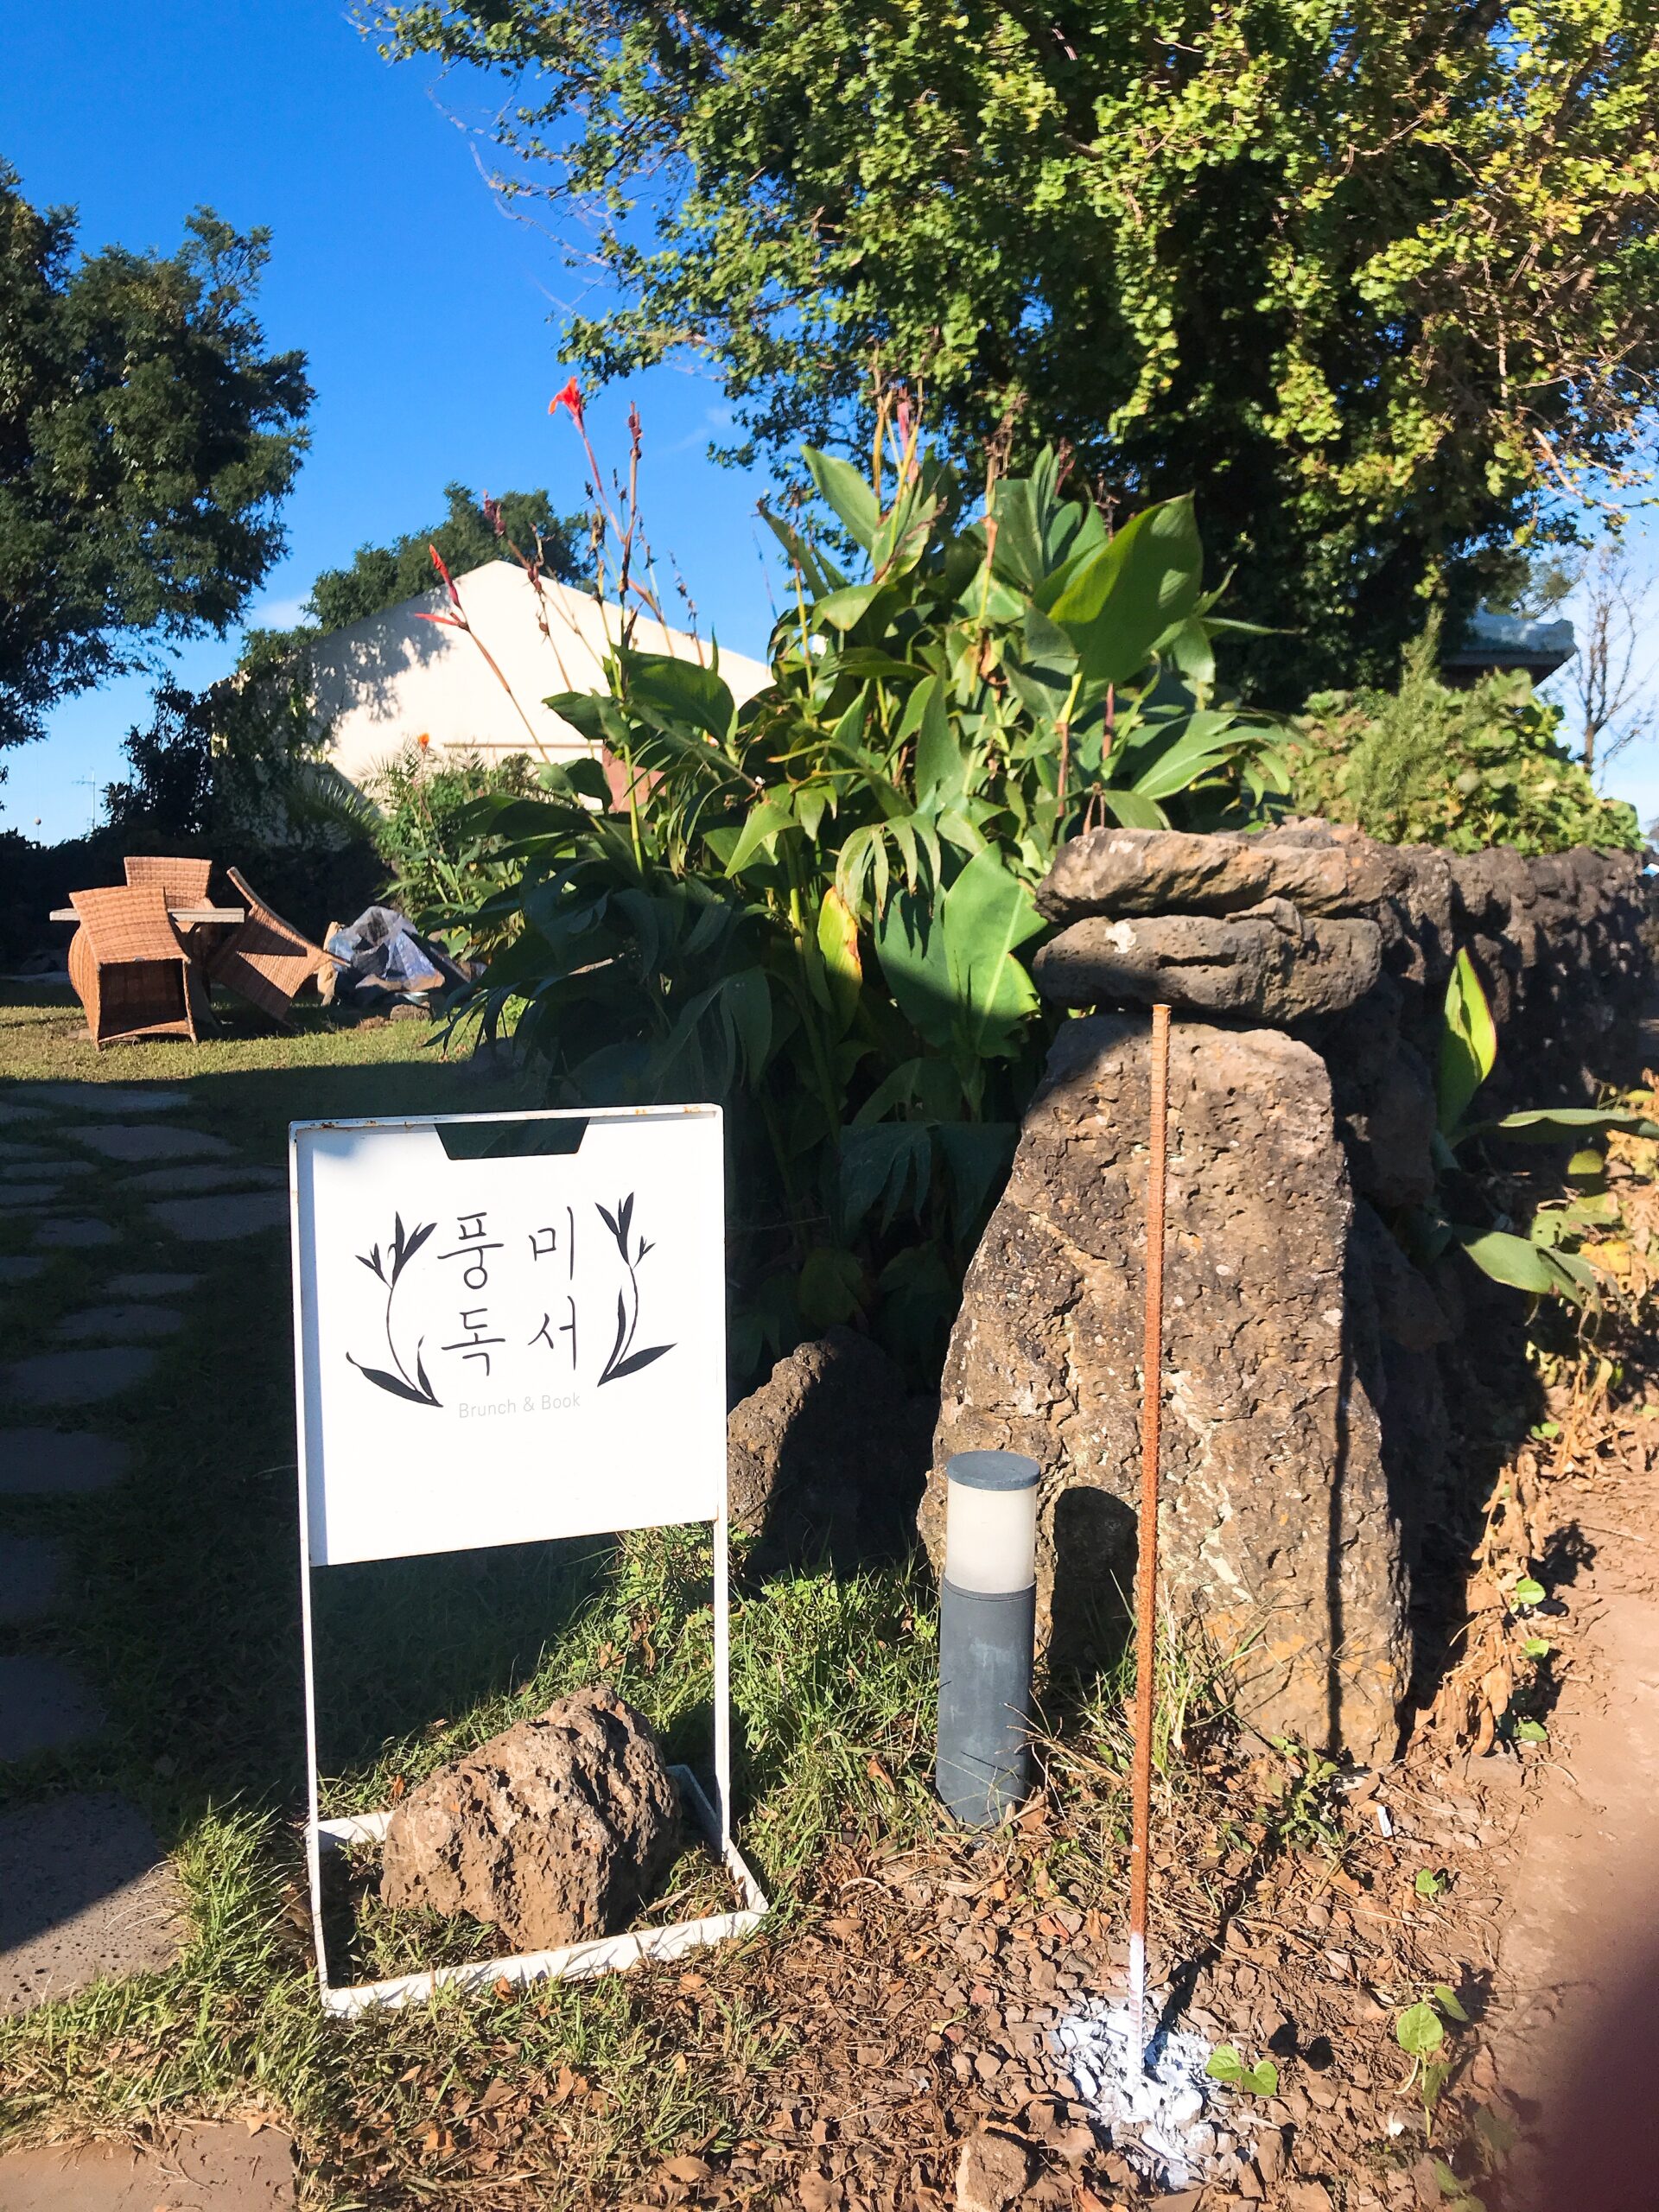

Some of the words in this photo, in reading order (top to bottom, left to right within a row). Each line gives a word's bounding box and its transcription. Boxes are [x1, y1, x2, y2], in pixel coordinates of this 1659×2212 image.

[436, 1205, 575, 1290] 풍미
[441, 1295, 577, 1376] 독서
[459, 1398, 516, 1419] Brunch
[523, 1395, 535, 1412] &
[542, 1392, 581, 1411] Book
